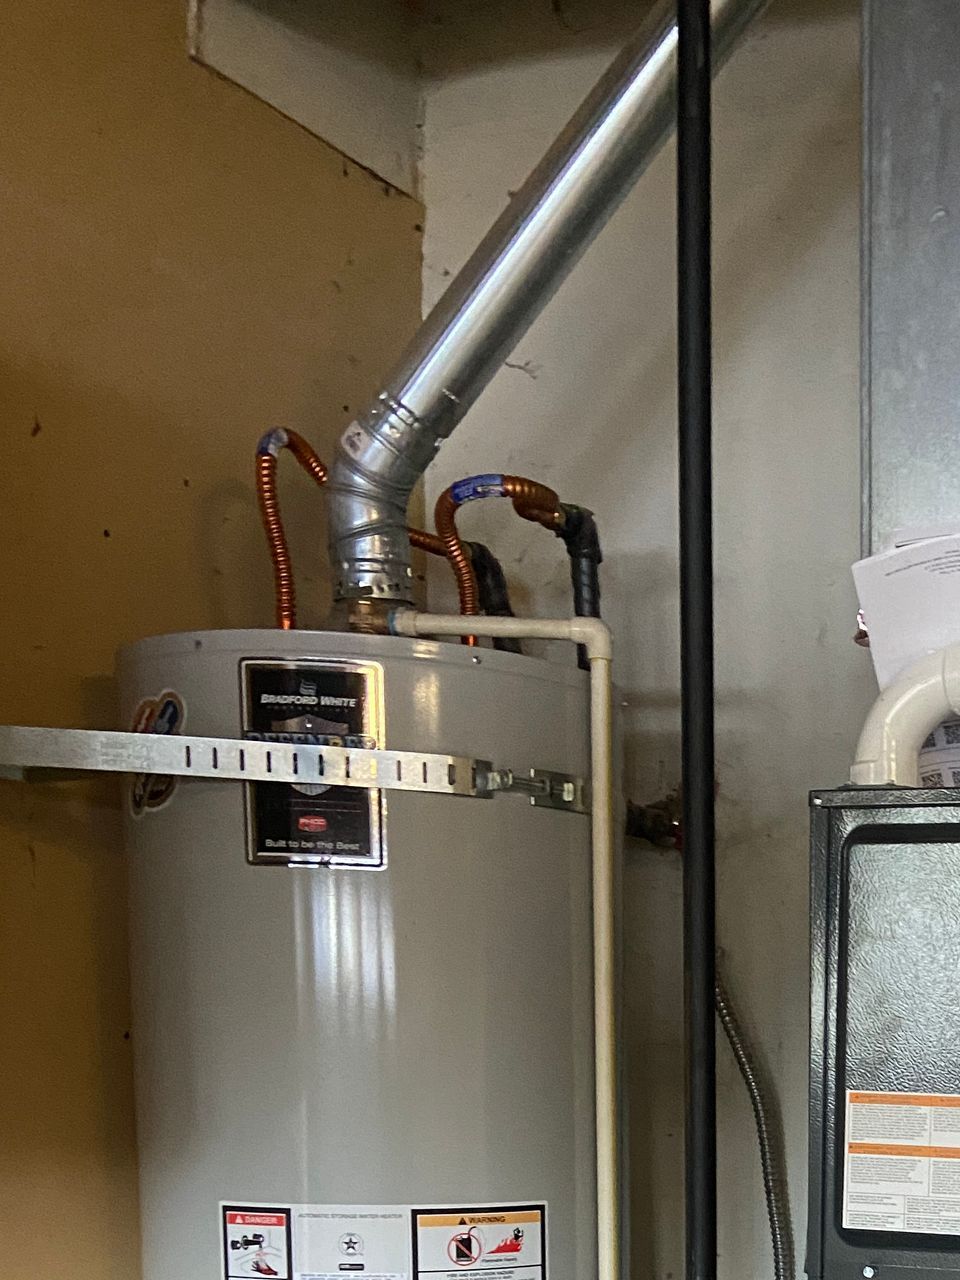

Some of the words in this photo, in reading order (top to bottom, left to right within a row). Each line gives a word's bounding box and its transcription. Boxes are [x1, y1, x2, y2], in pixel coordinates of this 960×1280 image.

[261, 694, 319, 705] BRADFORD
[320, 696, 357, 707] WHITE
[265, 839, 287, 848] Built
[289, 840, 299, 848] to
[301, 840, 314, 849] be
[316, 840, 333, 849] the
[336, 841, 360, 850] Best
[244, 1216, 278, 1224] DANGER
